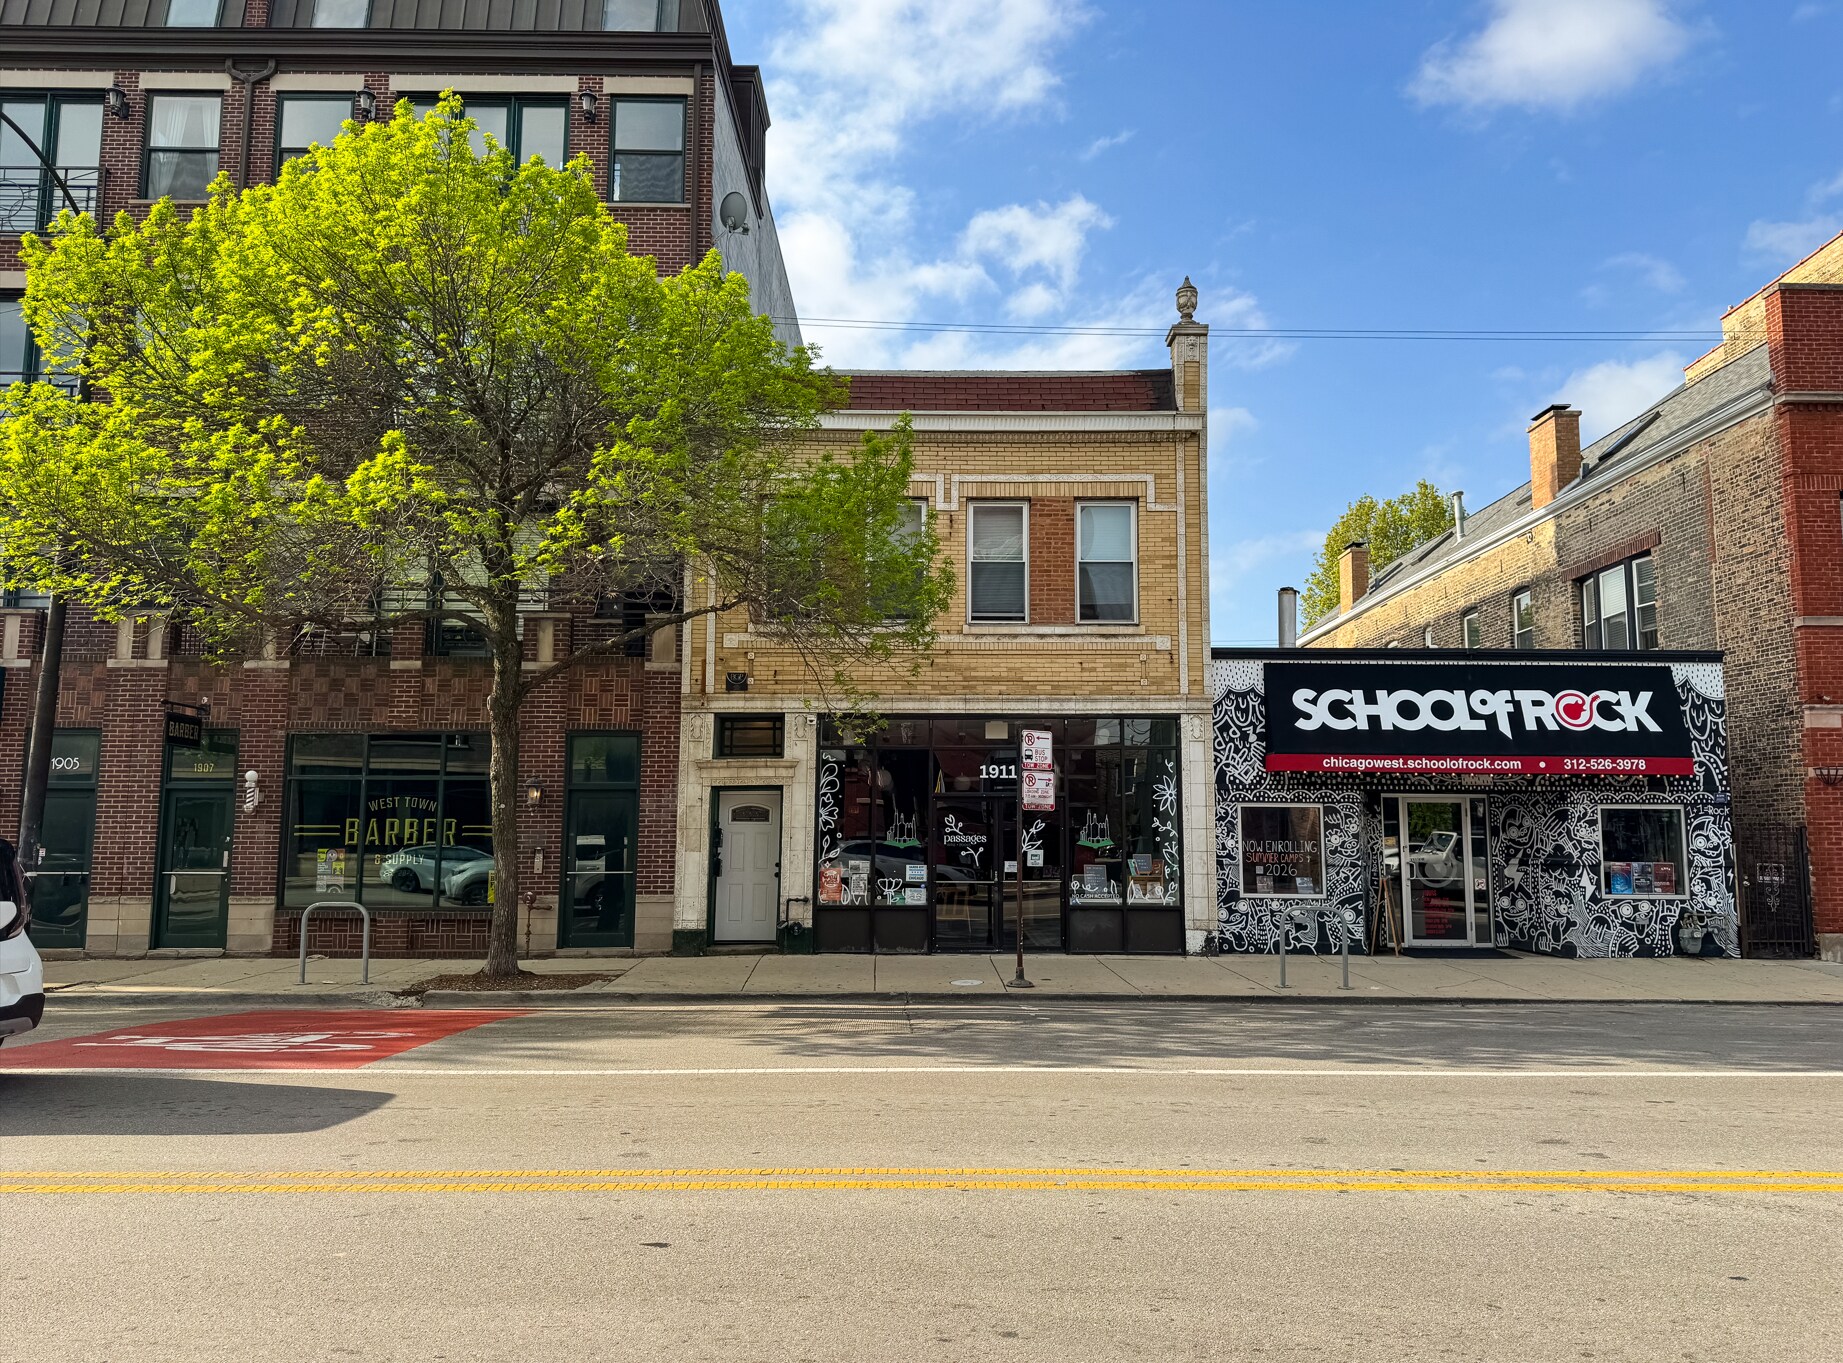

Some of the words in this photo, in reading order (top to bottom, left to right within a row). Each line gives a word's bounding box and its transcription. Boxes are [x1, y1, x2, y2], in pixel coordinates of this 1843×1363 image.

[1292, 688, 1487, 731] SCHOOL
[1513, 689, 1663, 732] ROCK
[168, 720, 200, 741] BARBER
[51, 757, 80, 770] 1905
[194, 763, 214, 773] 1907
[1323, 756, 1522, 771] chicagowest.schoolofrock.com
[1564, 758, 1647, 771] 312-526-3978
[979, 764, 1018, 779] 1911
[368, 796, 400, 812] WEST
[404, 796, 438, 812] TOWN
[344, 818, 458, 846] BARBER
[943, 834, 987, 845] passages
[1242, 841, 1263, 853] NOW
[374, 854, 382, 865] &
[385, 854, 425, 865] SUPPLY
[1246, 852, 1279, 863] SUMMER
[1280, 853, 1304, 863] CAMPS
[1265, 863, 1298, 876] 2026
